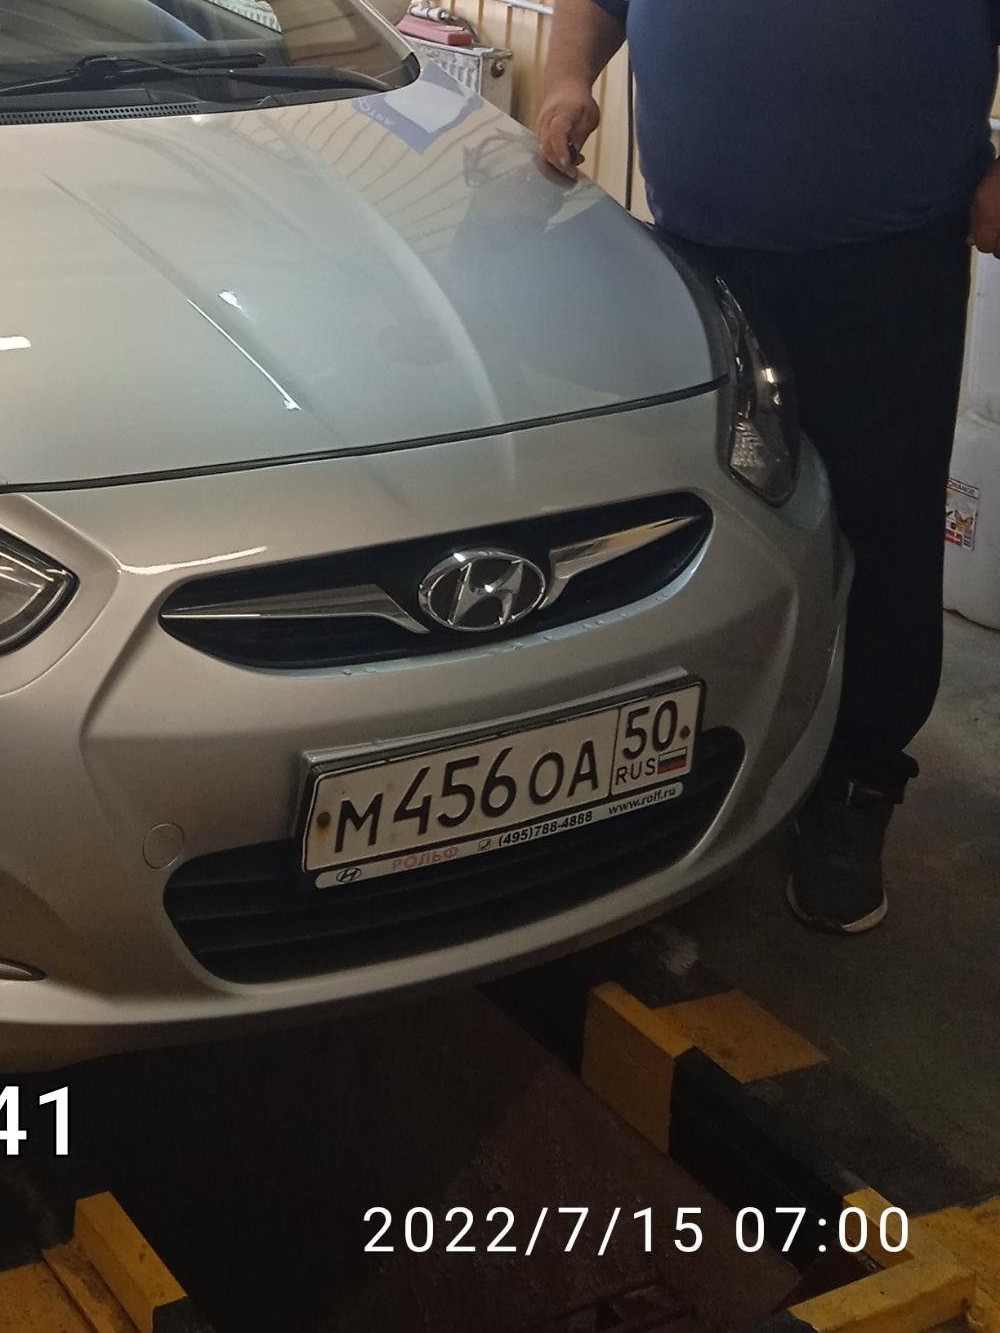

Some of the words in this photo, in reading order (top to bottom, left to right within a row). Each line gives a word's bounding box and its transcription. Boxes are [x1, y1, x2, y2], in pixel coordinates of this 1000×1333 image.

[334, 739, 600, 854] М456ОА
[622, 699, 679, 761] 50
[614, 758, 657, 786] RUS
[391, 847, 459, 871] РОЛЬФ
[498, 810, 593, 847] (495)788-4888
[608, 786, 677, 815] www.rolf.ru
